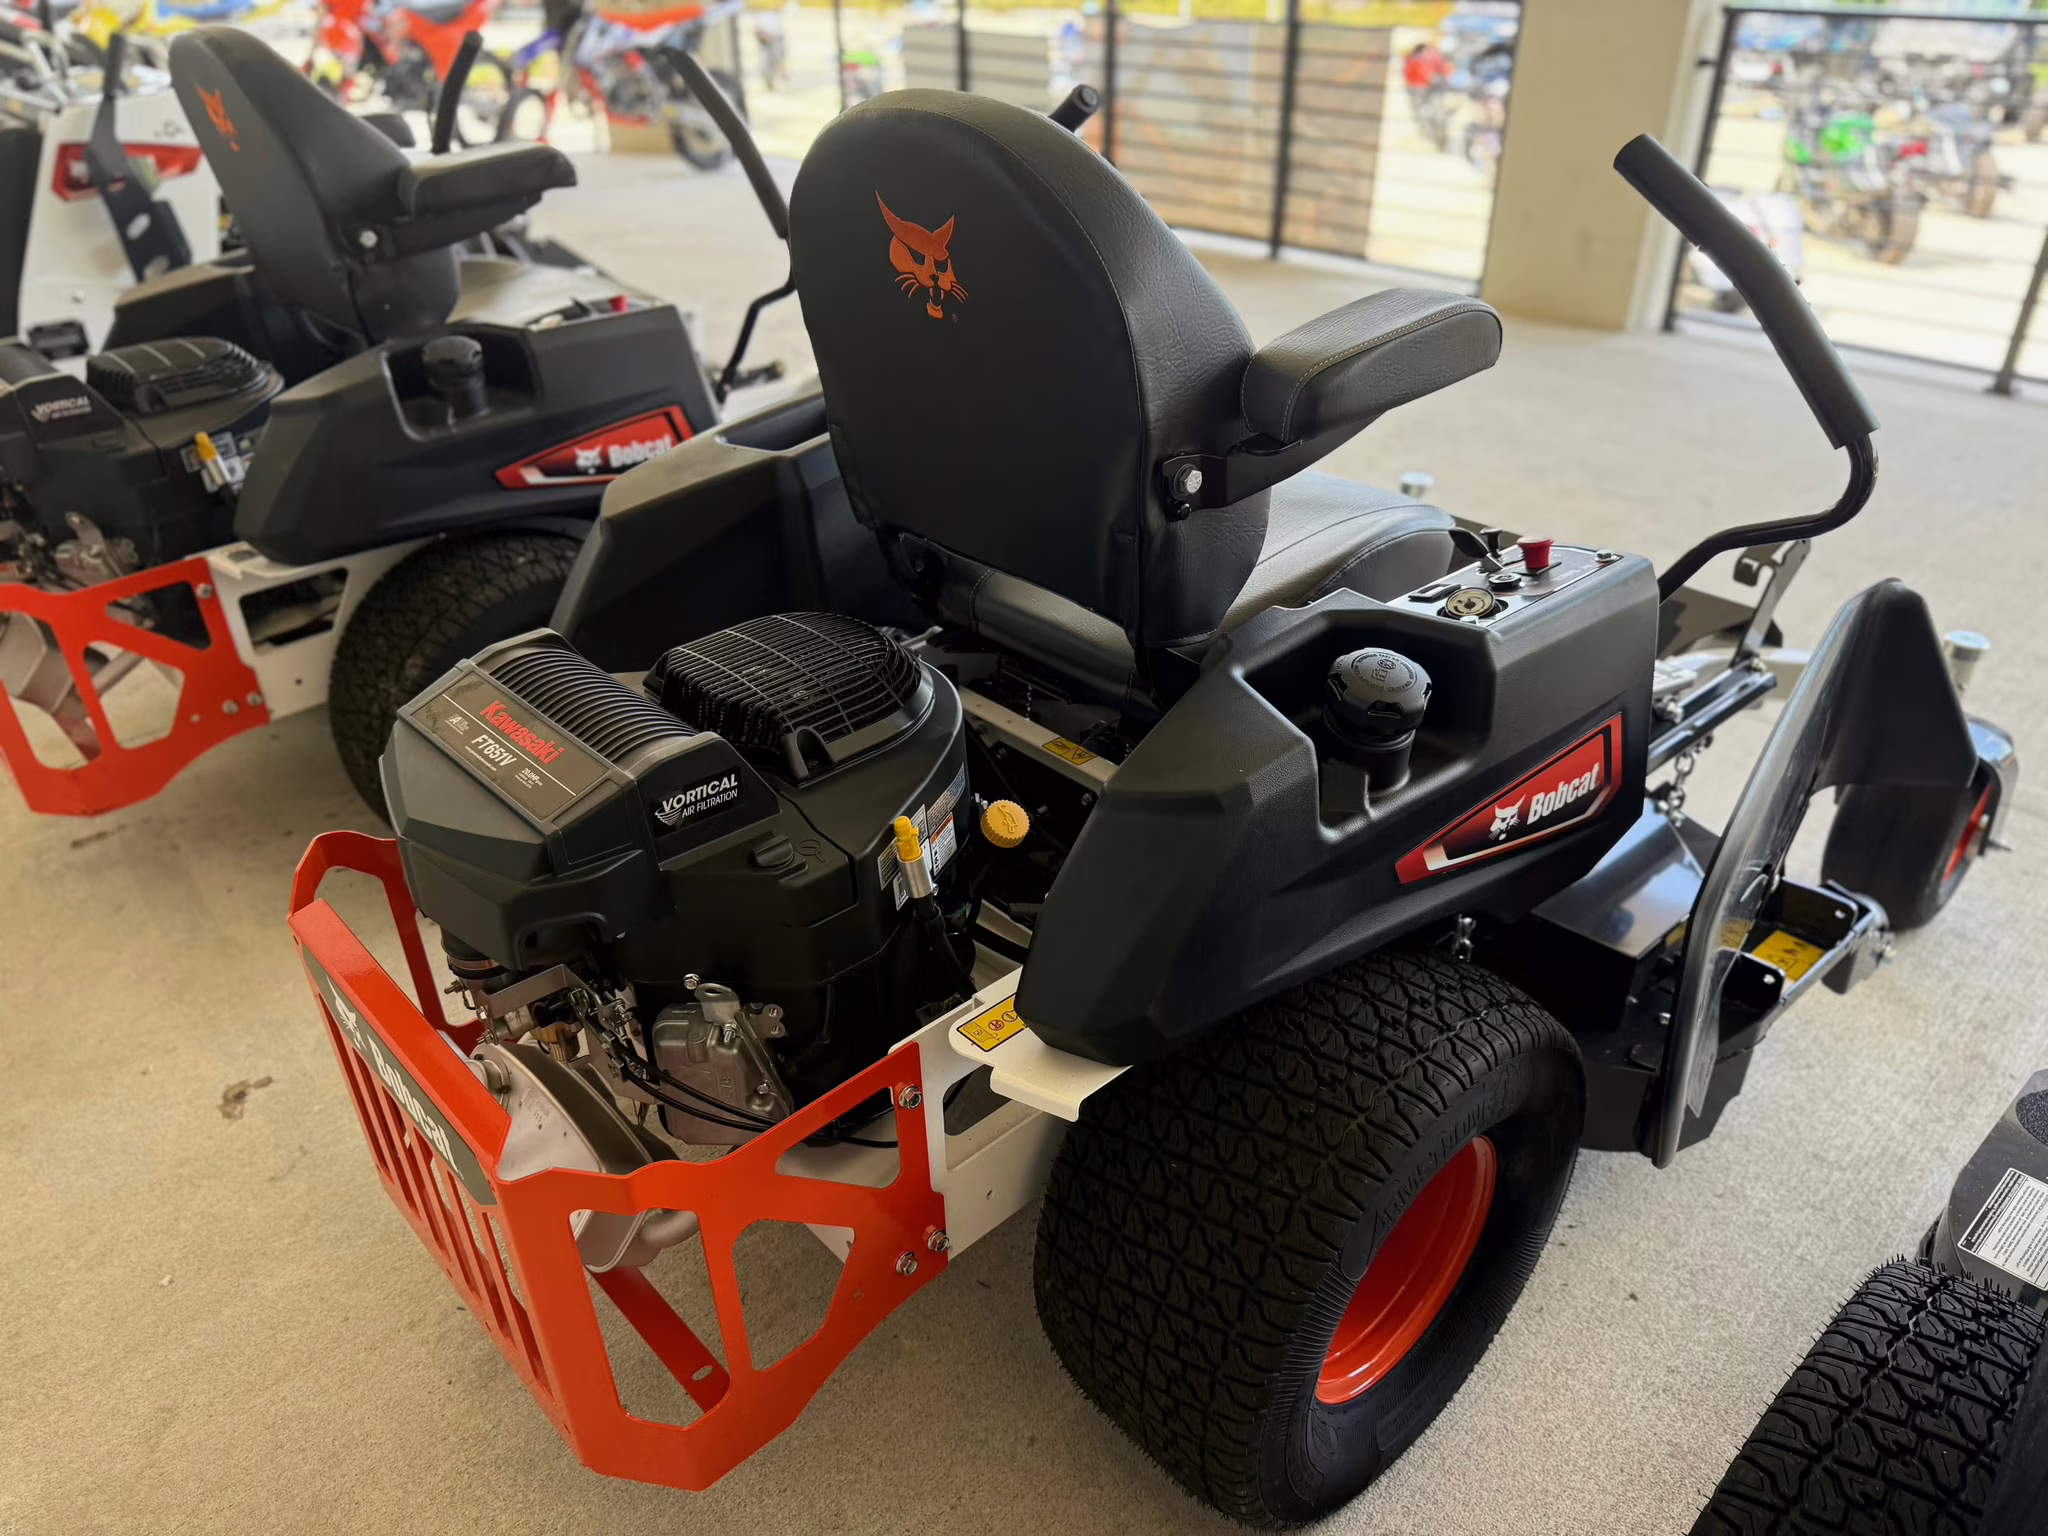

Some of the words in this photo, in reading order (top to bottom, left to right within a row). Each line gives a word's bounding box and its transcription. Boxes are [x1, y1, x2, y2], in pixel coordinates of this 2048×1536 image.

[608, 434, 672, 468] Bobcat
[471, 734, 518, 767] FT651V
[479, 700, 566, 765] Kawasaki
[662, 773, 738, 813] VORTICAL
[681, 804, 695, 818] AIR
[696, 788, 738, 812] FILTRATION
[1526, 761, 1600, 825] Bobcat
[366, 1033, 460, 1174] Bobcat
